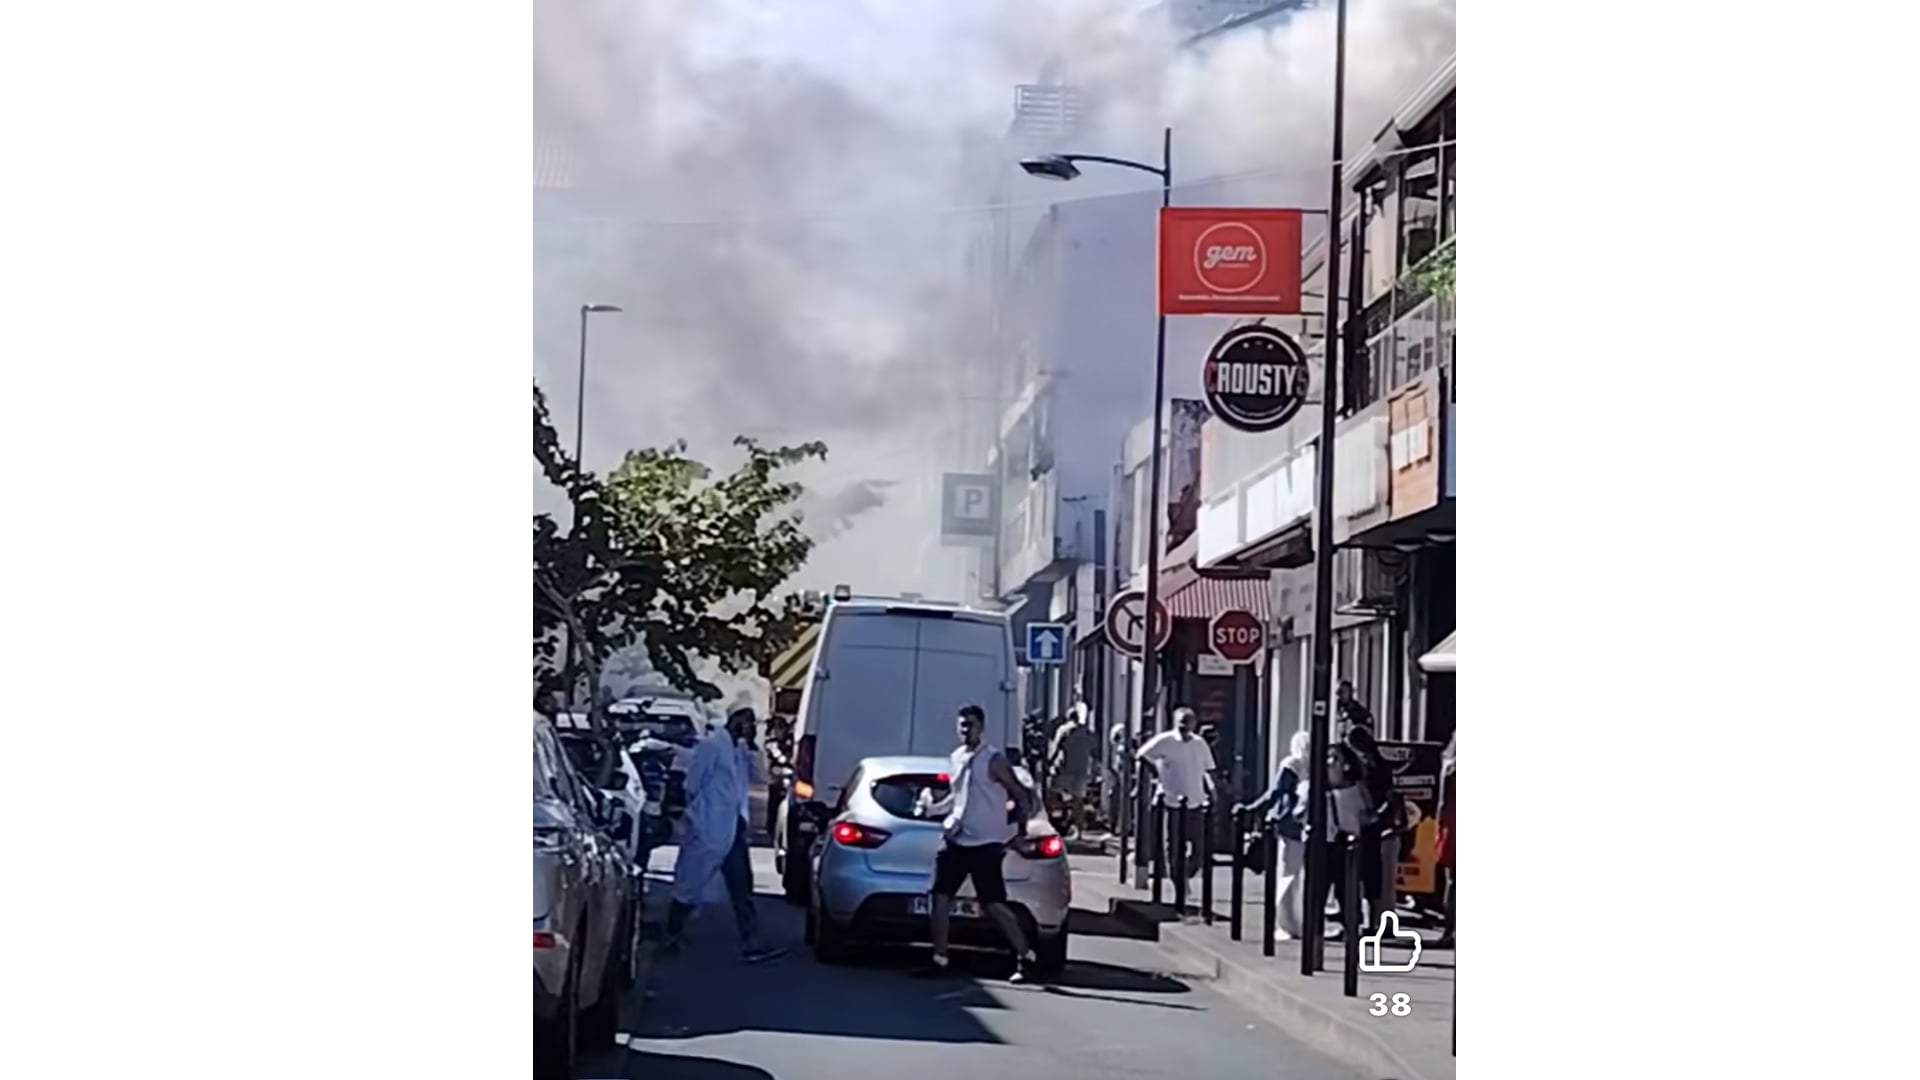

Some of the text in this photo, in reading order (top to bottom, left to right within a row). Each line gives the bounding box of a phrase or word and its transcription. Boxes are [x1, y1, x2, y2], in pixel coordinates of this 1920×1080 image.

[1203, 245, 1257, 269] gem
[964, 488, 983, 514] P
[1216, 627, 1260, 644] STOP
